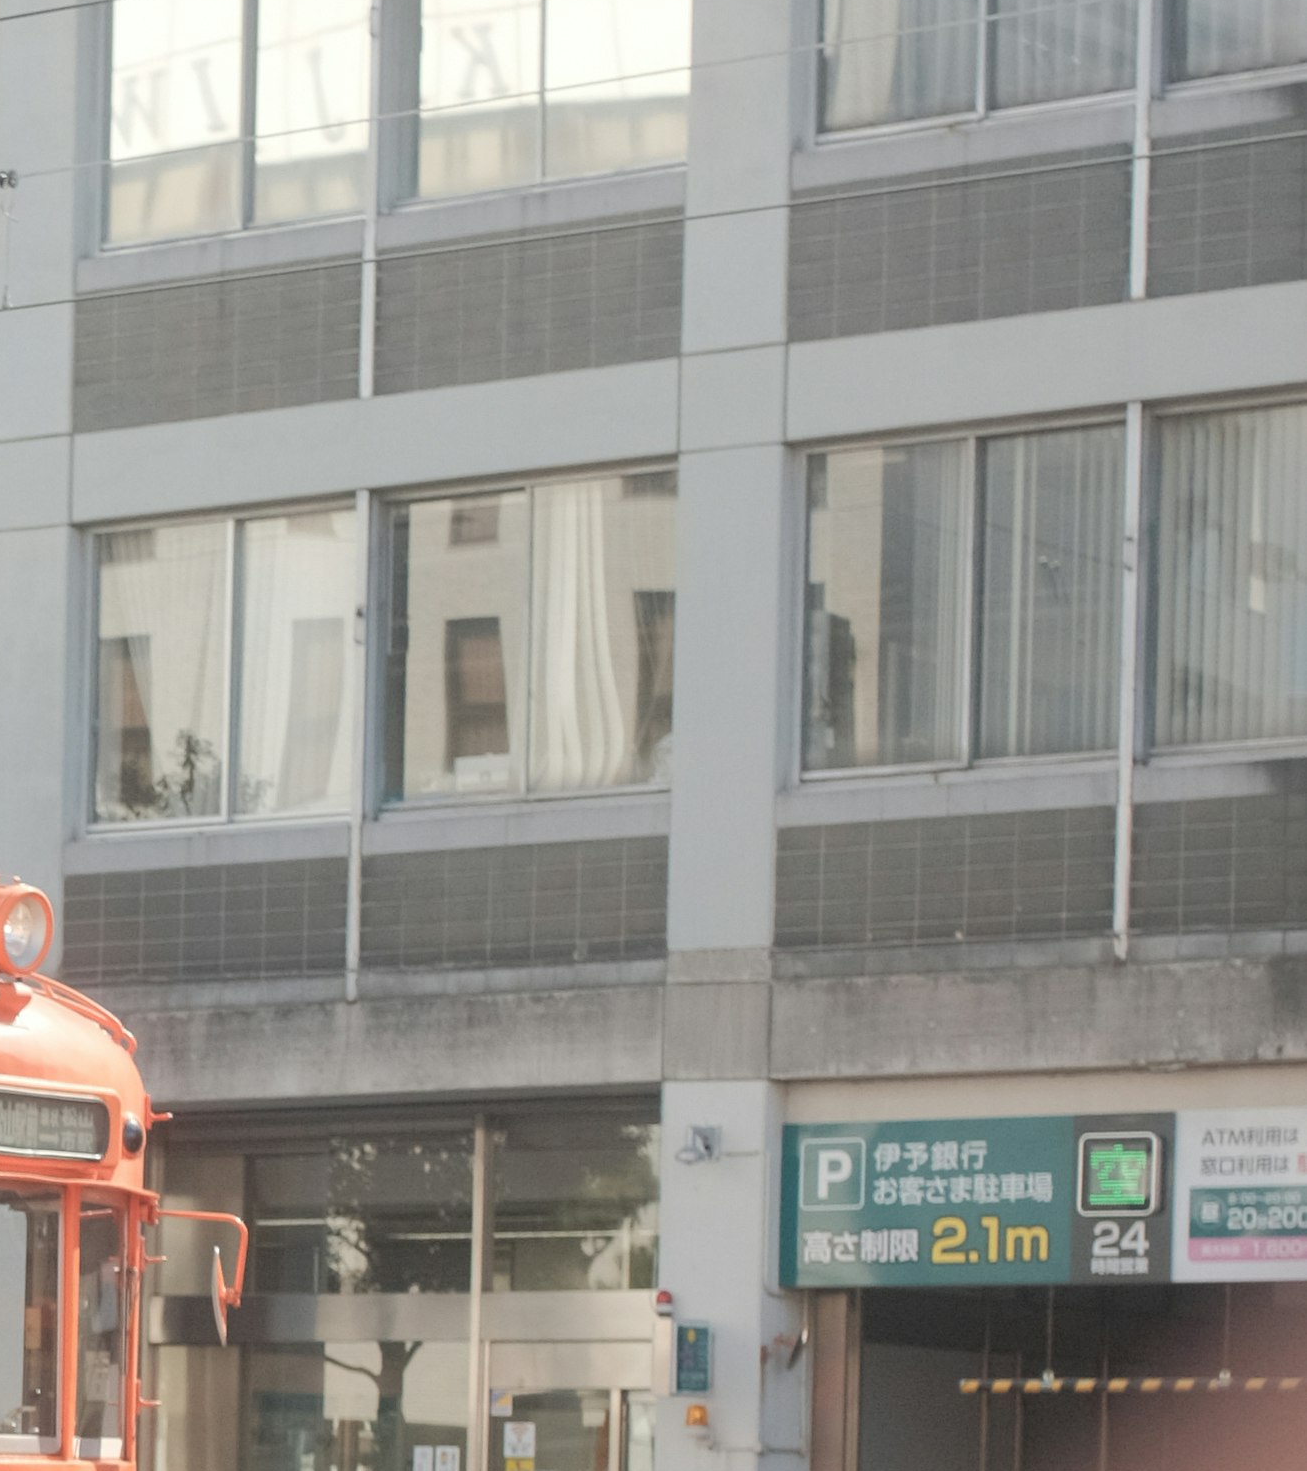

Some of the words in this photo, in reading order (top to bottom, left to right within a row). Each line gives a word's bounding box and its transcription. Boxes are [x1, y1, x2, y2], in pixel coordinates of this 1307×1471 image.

[1201, 1127, 1299, 1147] ATM利用は
[817, 1149, 853, 1200] P
[873, 1140, 988, 1172] 伊予銀行
[1089, 1143, 1147, 1206] 空
[872, 1172, 1054, 1206] お客さま駐車場
[803, 1228, 919, 1263] 高さ制限
[930, 1215, 1049, 1264] 2.1m
[1091, 1220, 1150, 1257] 24
